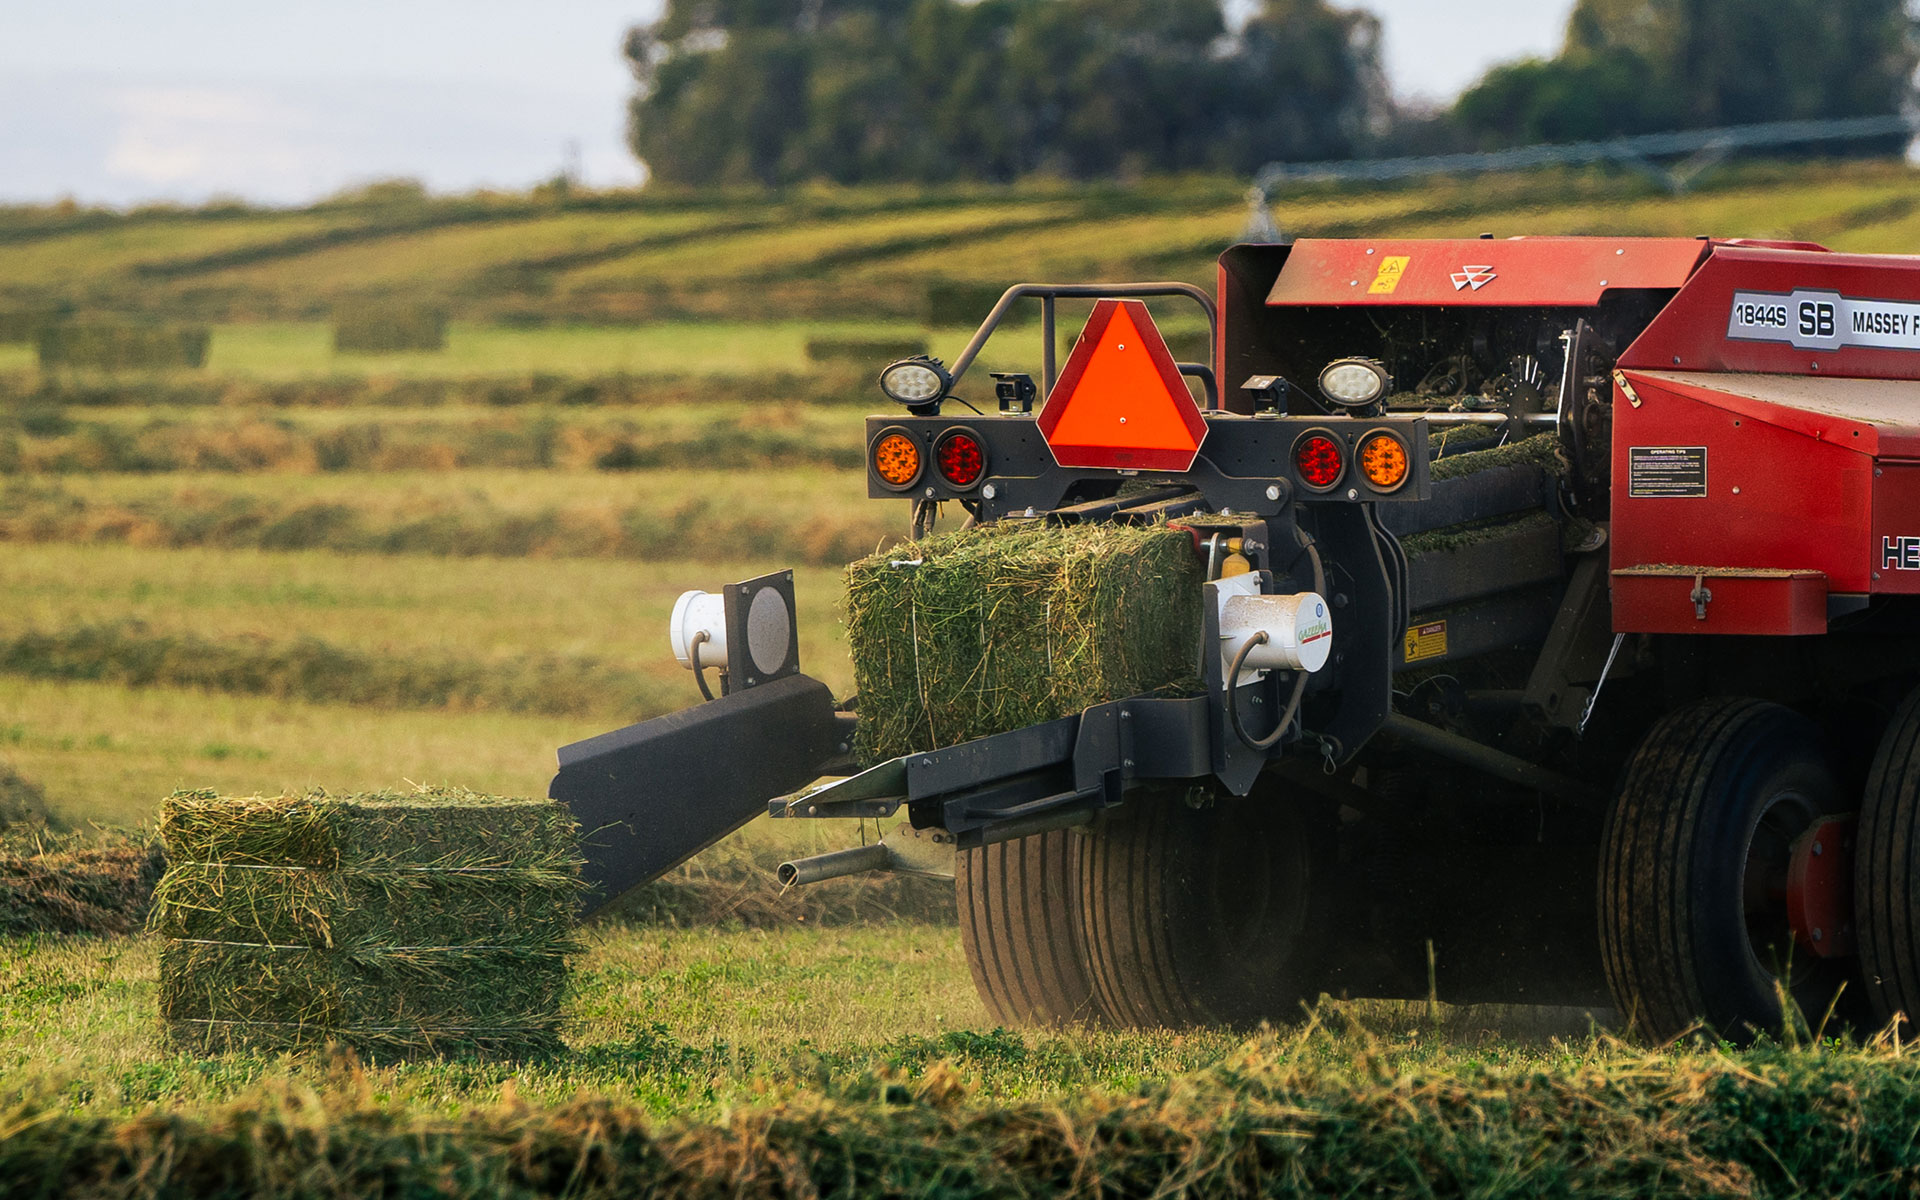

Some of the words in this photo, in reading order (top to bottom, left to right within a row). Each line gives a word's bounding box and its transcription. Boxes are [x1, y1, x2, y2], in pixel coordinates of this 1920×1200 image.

[1736, 303, 1788, 327] 1844S
[1799, 301, 1835, 337] SB
[1852, 311, 1909, 335] MASSEY
